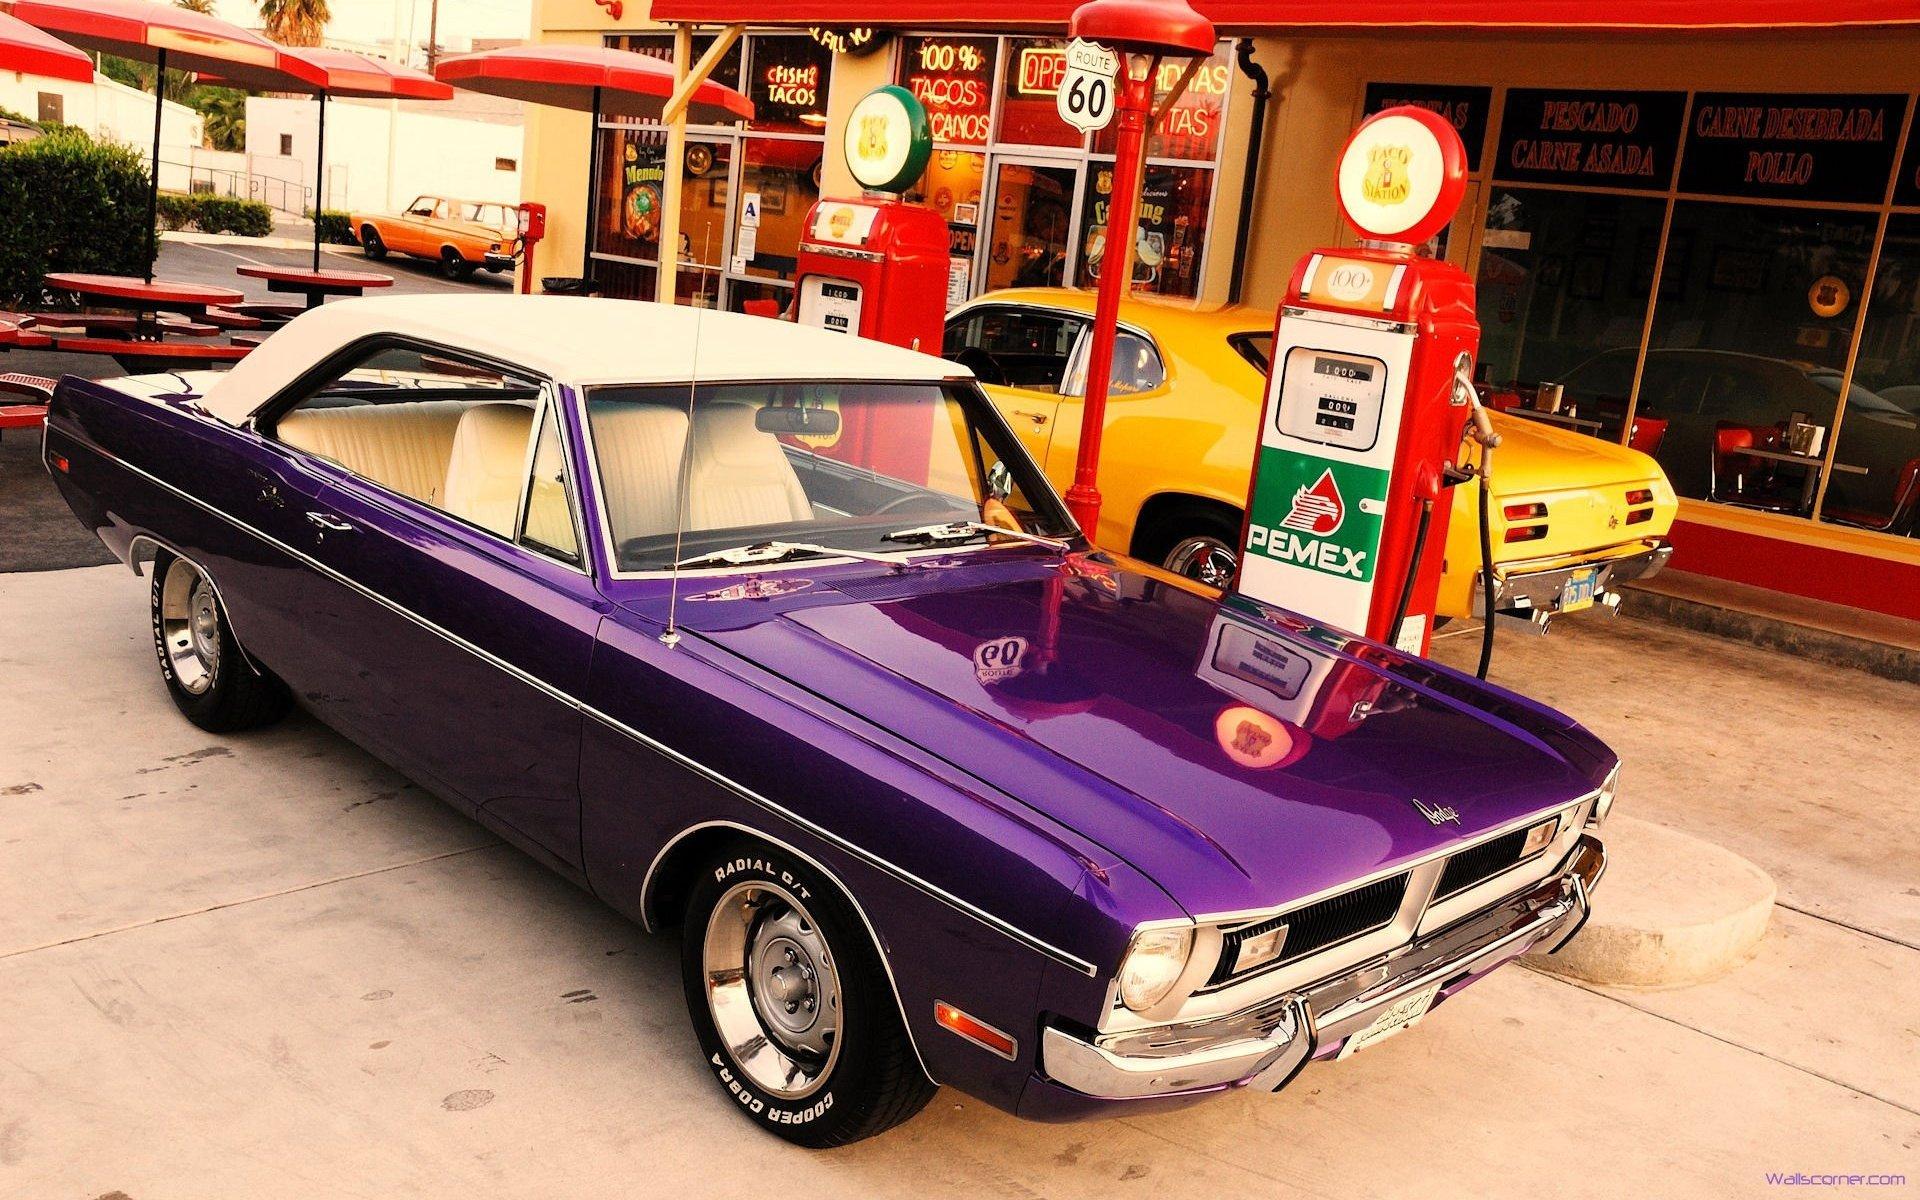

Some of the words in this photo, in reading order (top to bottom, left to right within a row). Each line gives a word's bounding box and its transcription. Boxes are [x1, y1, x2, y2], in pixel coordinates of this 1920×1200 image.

[920, 44, 954, 71] 100
[1024, 55, 1067, 88] OPE
[1076, 51, 1111, 70] ROUTE
[768, 84, 816, 106] TACOS
[911, 79, 977, 106] TACOS
[1068, 76, 1106, 118] 60
[930, 112, 990, 140] CANOS
[1540, 101, 1639, 133] PESCADO
[1696, 106, 1763, 140] CARNE
[1762, 107, 1884, 142] DESEBRADA
[1511, 139, 1583, 172] CARNE
[1582, 143, 1655, 175] ASADA
[1744, 151, 1814, 185] POLLO
[1364, 178, 1407, 200] STATION
[745, 201, 756, 217] A
[1247, 524, 1367, 578] PEMEX
[714, 858, 776, 882] RADIAL
[711, 1052, 764, 1114] COBRA
[767, 1091, 834, 1125] COOPER
